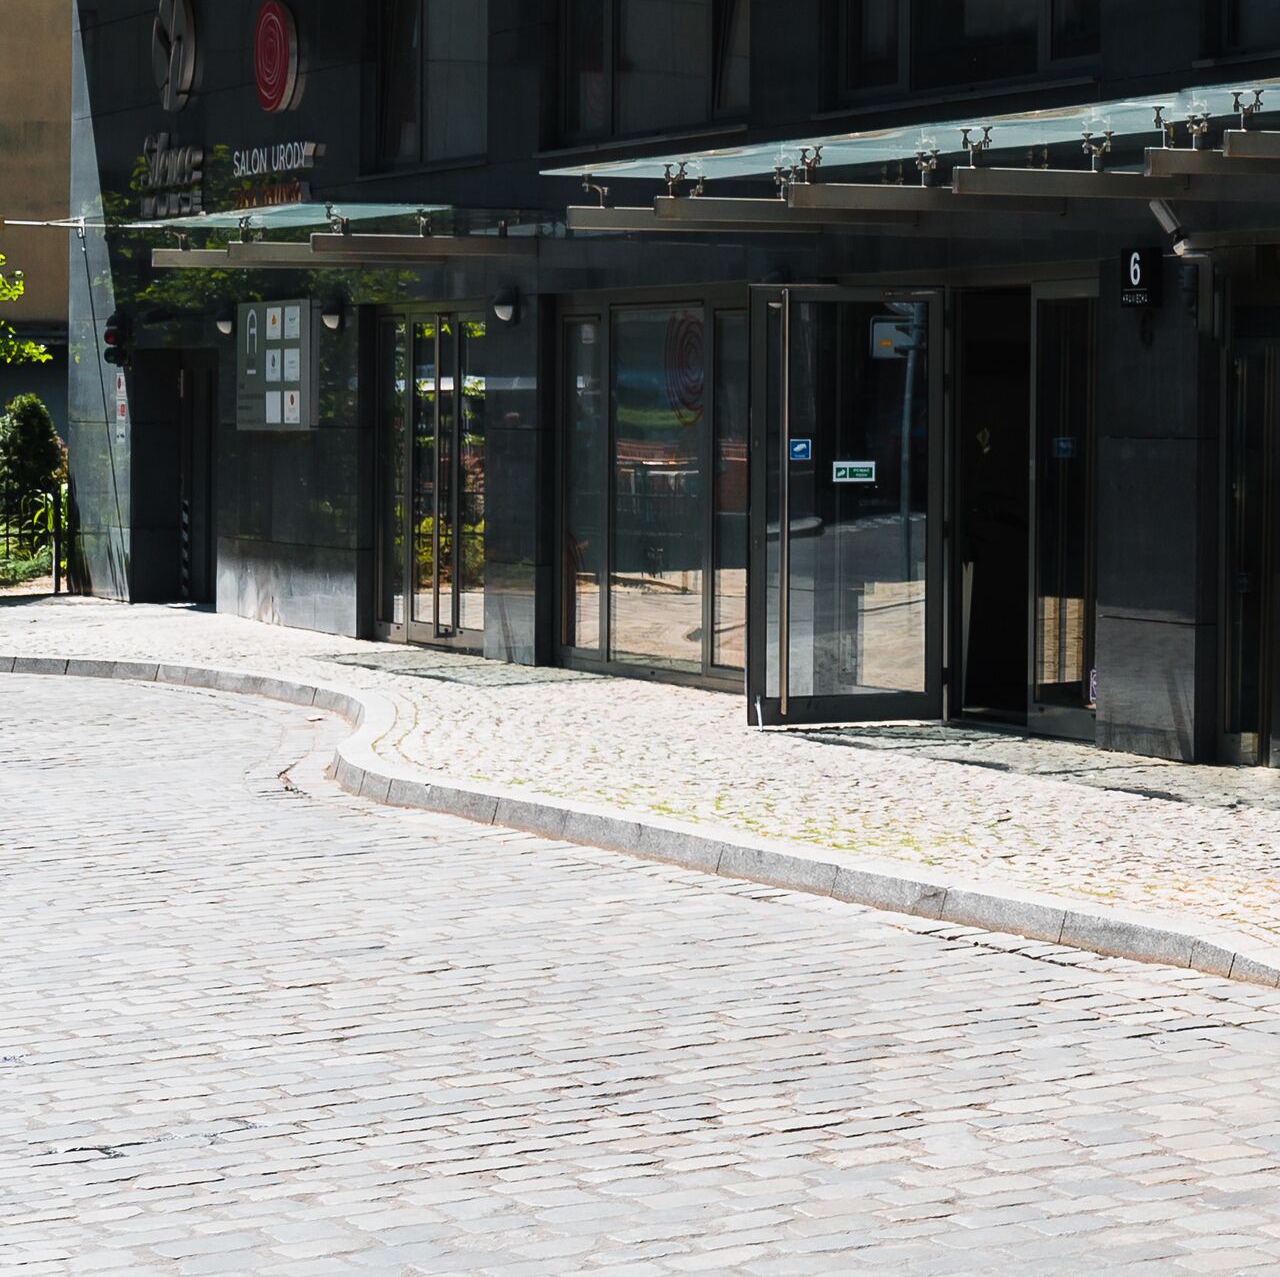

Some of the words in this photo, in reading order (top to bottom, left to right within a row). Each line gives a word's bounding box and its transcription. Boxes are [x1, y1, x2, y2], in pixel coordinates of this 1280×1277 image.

[233, 147, 268, 178] SALON
[271, 141, 308, 171] URODY
[1129, 251, 1141, 287] 6
